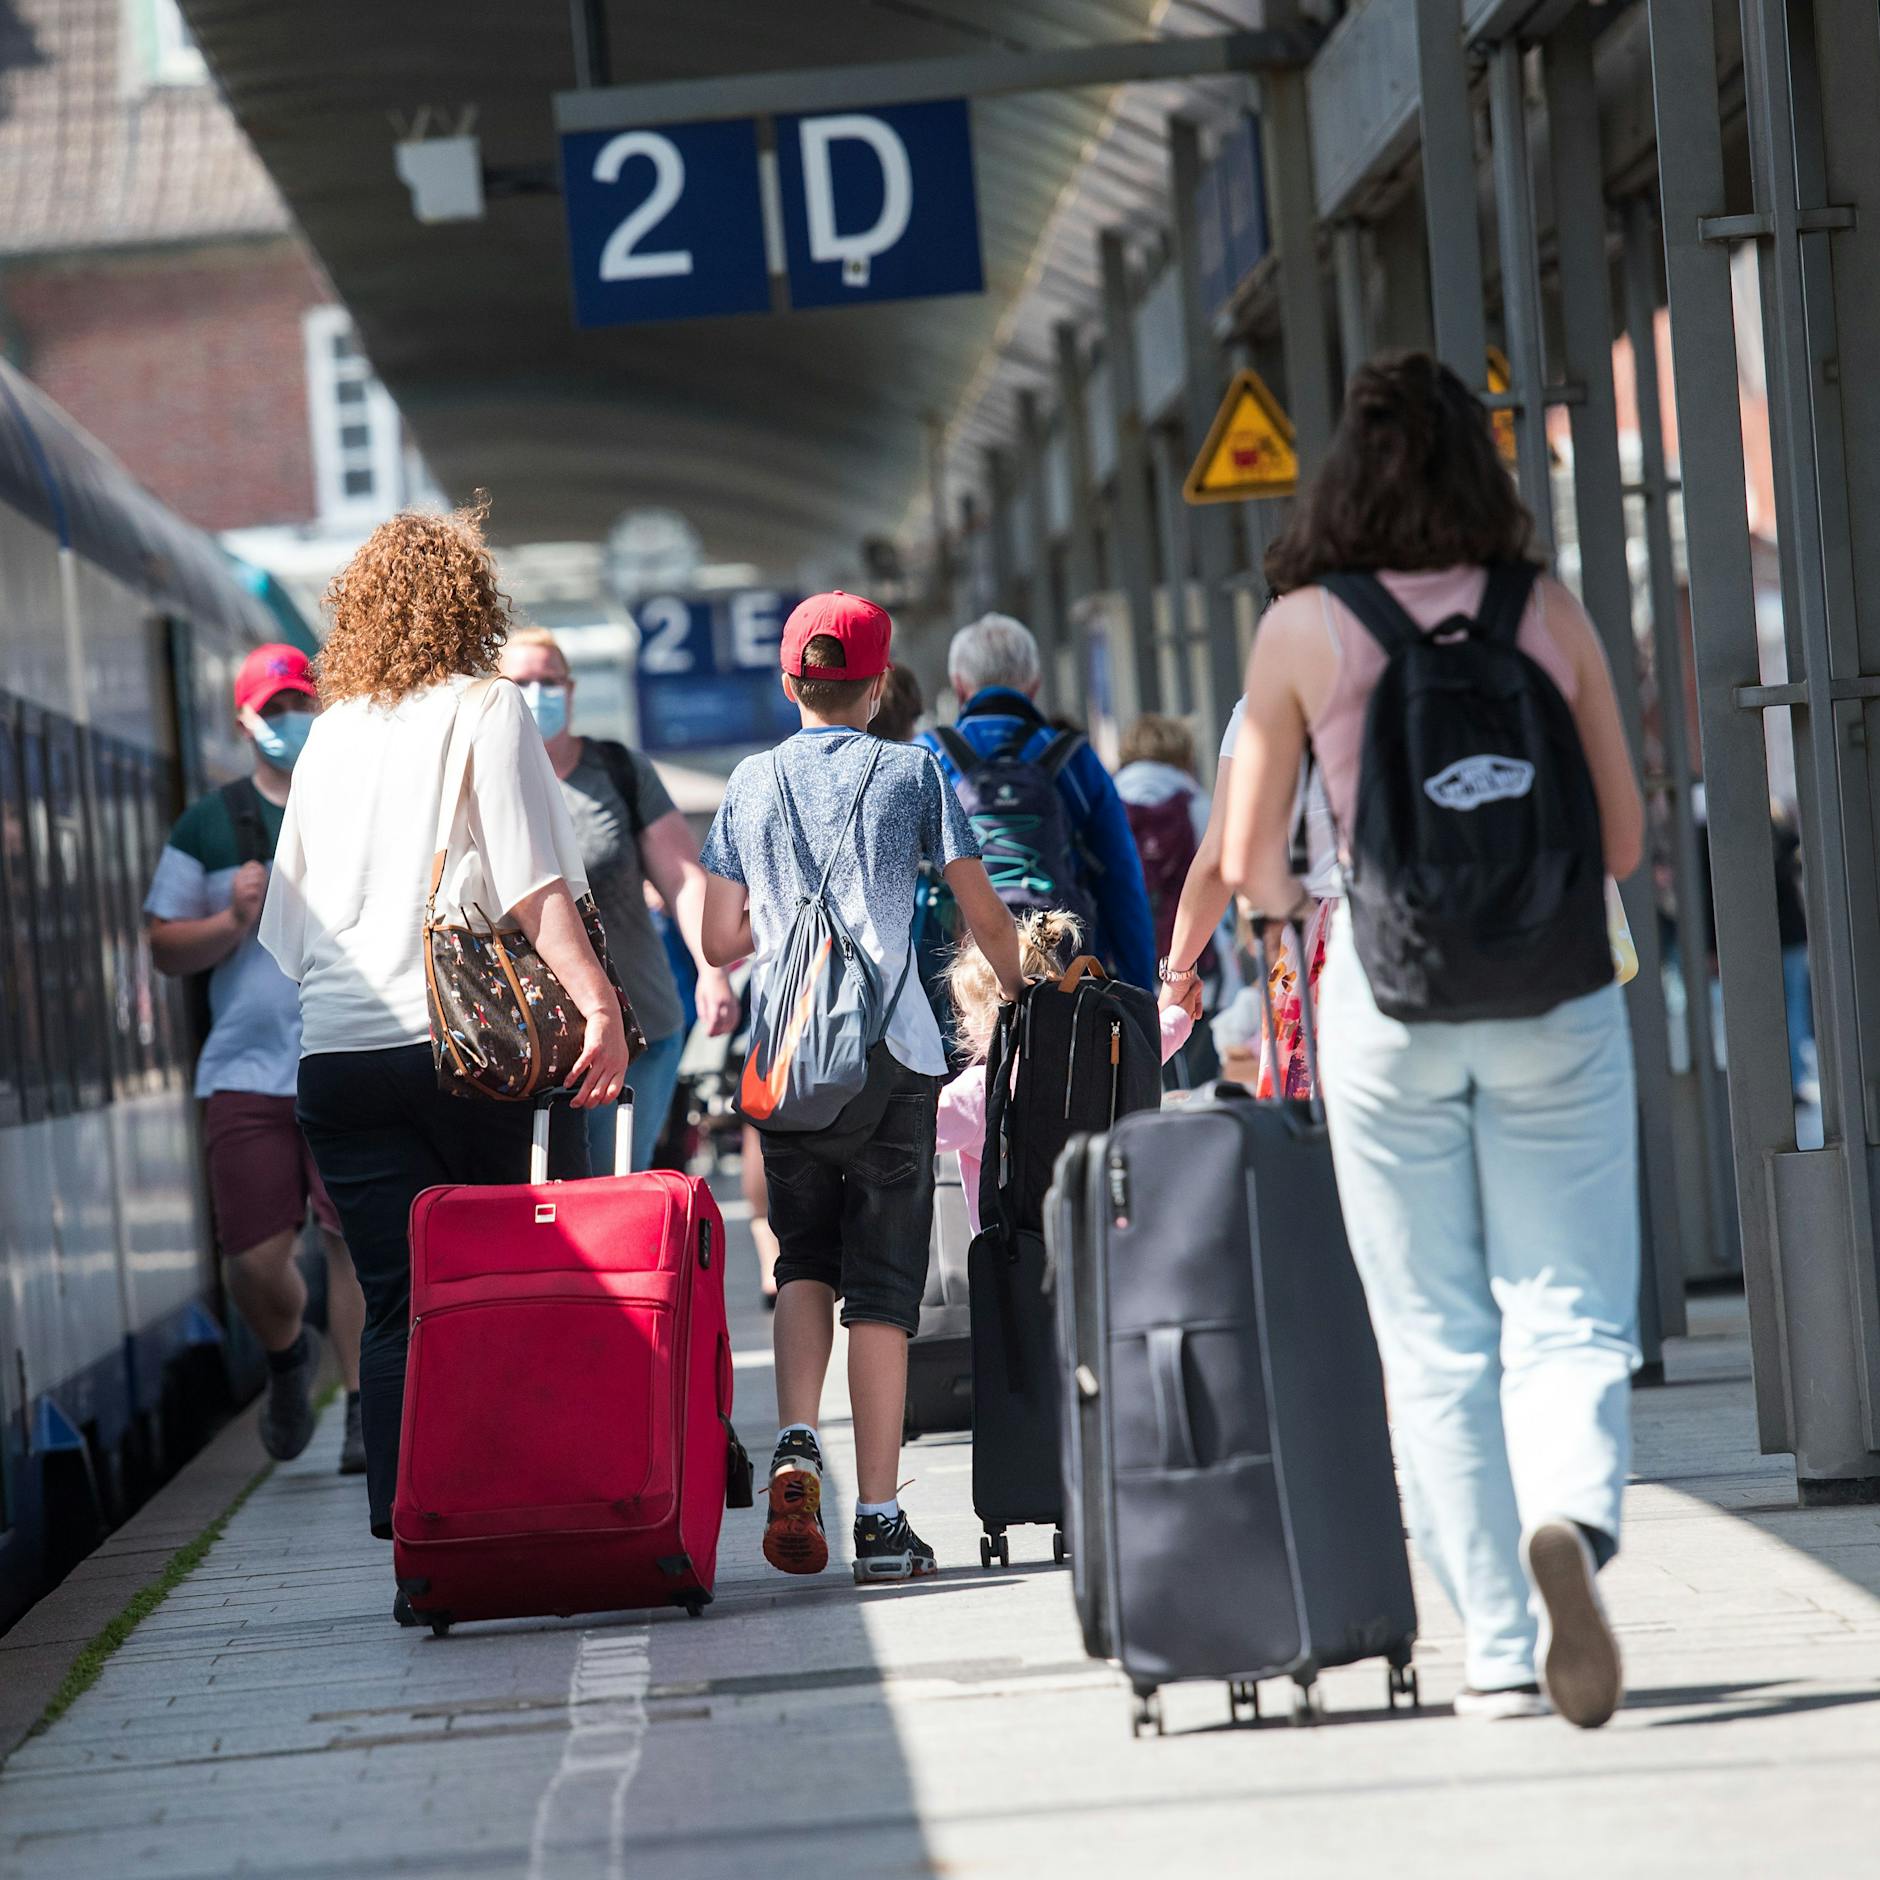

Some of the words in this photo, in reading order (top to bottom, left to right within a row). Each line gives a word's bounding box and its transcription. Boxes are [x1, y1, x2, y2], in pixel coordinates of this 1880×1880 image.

[593, 131, 693, 281] 2
[799, 114, 913, 263] D
[642, 596, 694, 674] 2
[733, 592, 781, 668] E
